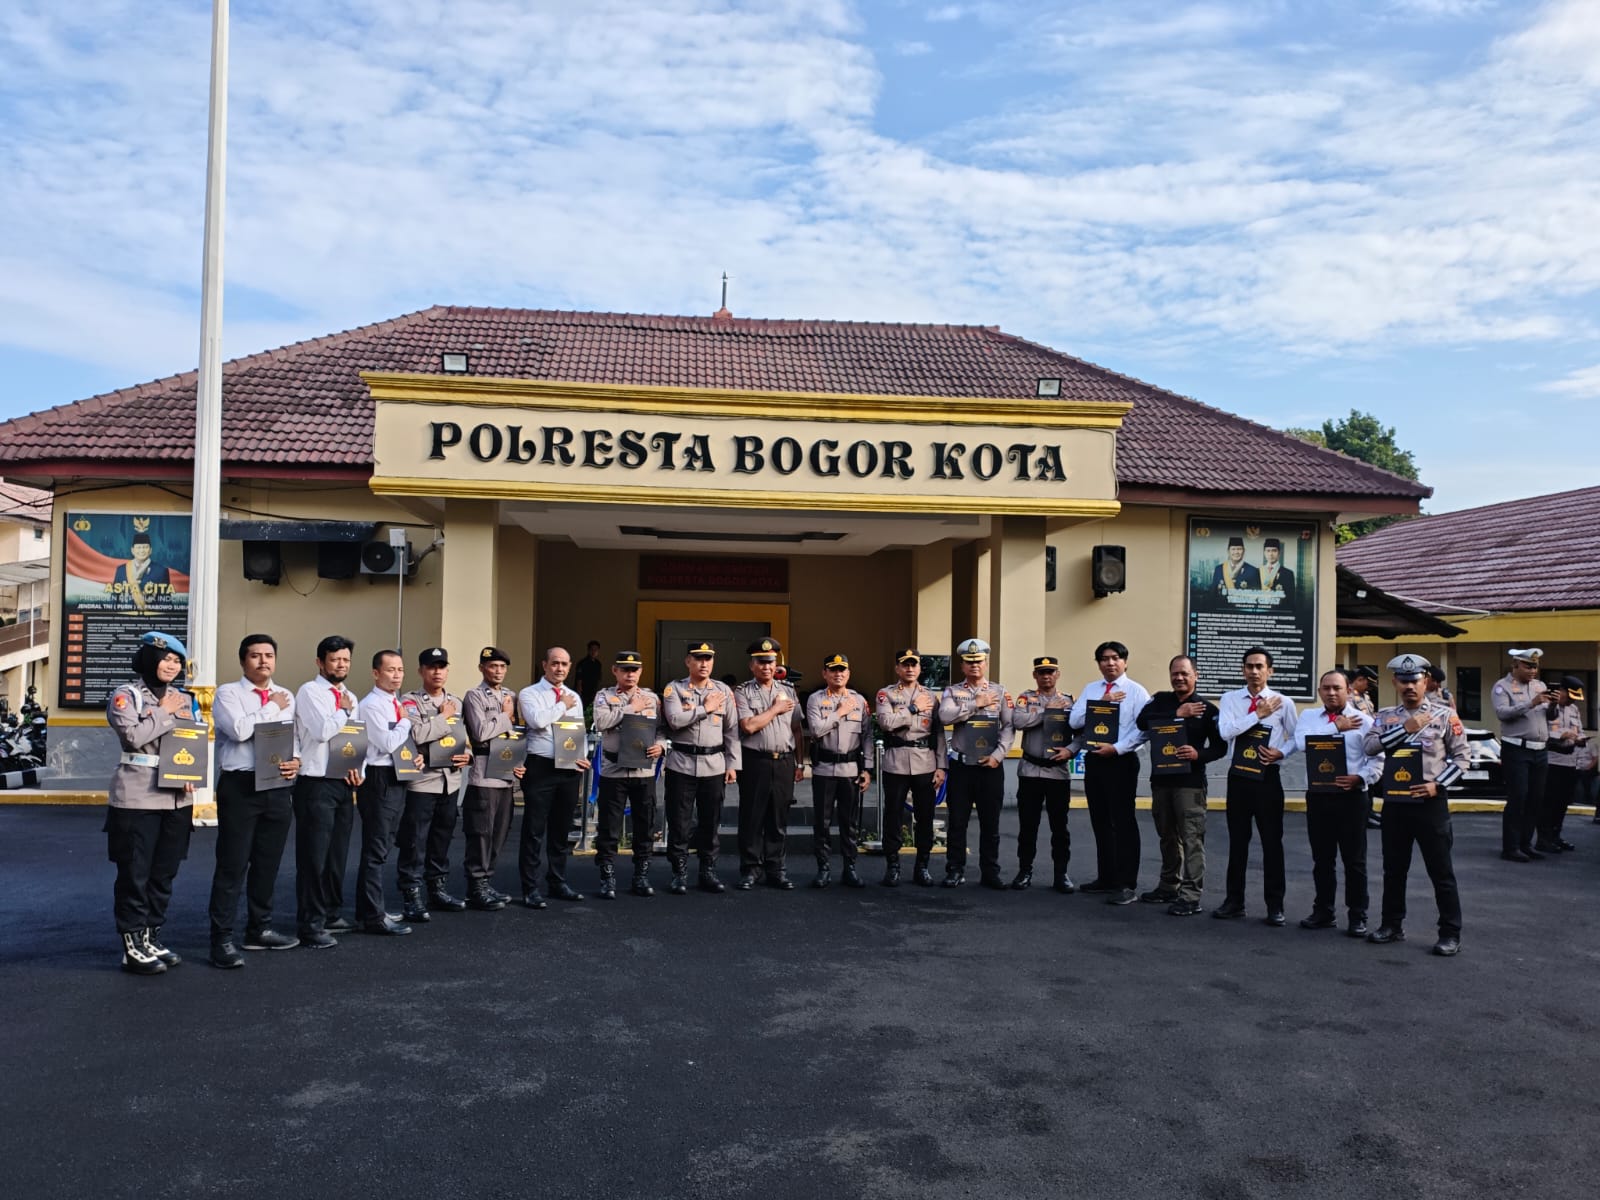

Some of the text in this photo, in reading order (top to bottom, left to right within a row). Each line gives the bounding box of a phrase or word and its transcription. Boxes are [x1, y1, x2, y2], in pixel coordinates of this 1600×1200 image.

[428, 421, 1067, 481] POLRESTA BOGOR KOTA
[104, 583, 176, 594] ASTA CITA
